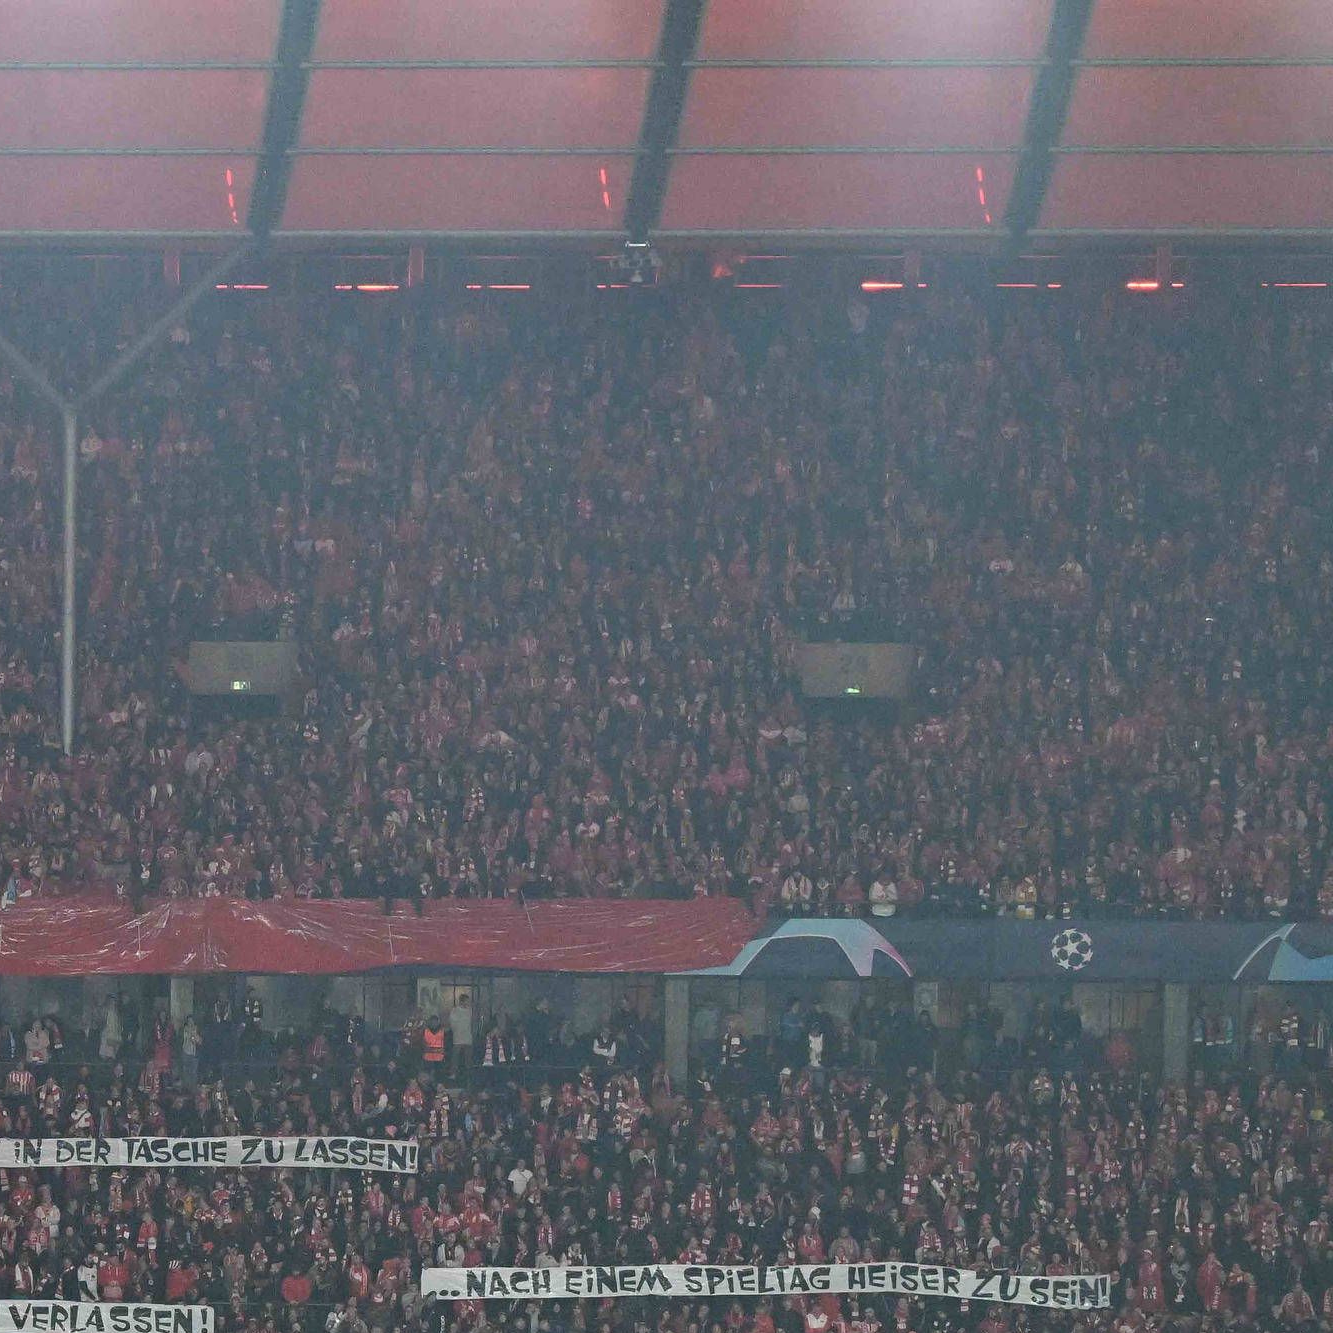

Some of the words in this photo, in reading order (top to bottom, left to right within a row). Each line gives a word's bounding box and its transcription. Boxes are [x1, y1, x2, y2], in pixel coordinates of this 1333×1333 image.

[56, 1138, 110, 1165] DER
[122, 1138, 227, 1165] TASCHE
[240, 1138, 285, 1164] ZU
[295, 1138, 416, 1171] LASSEN!
[971, 1266, 1022, 1300] ZU
